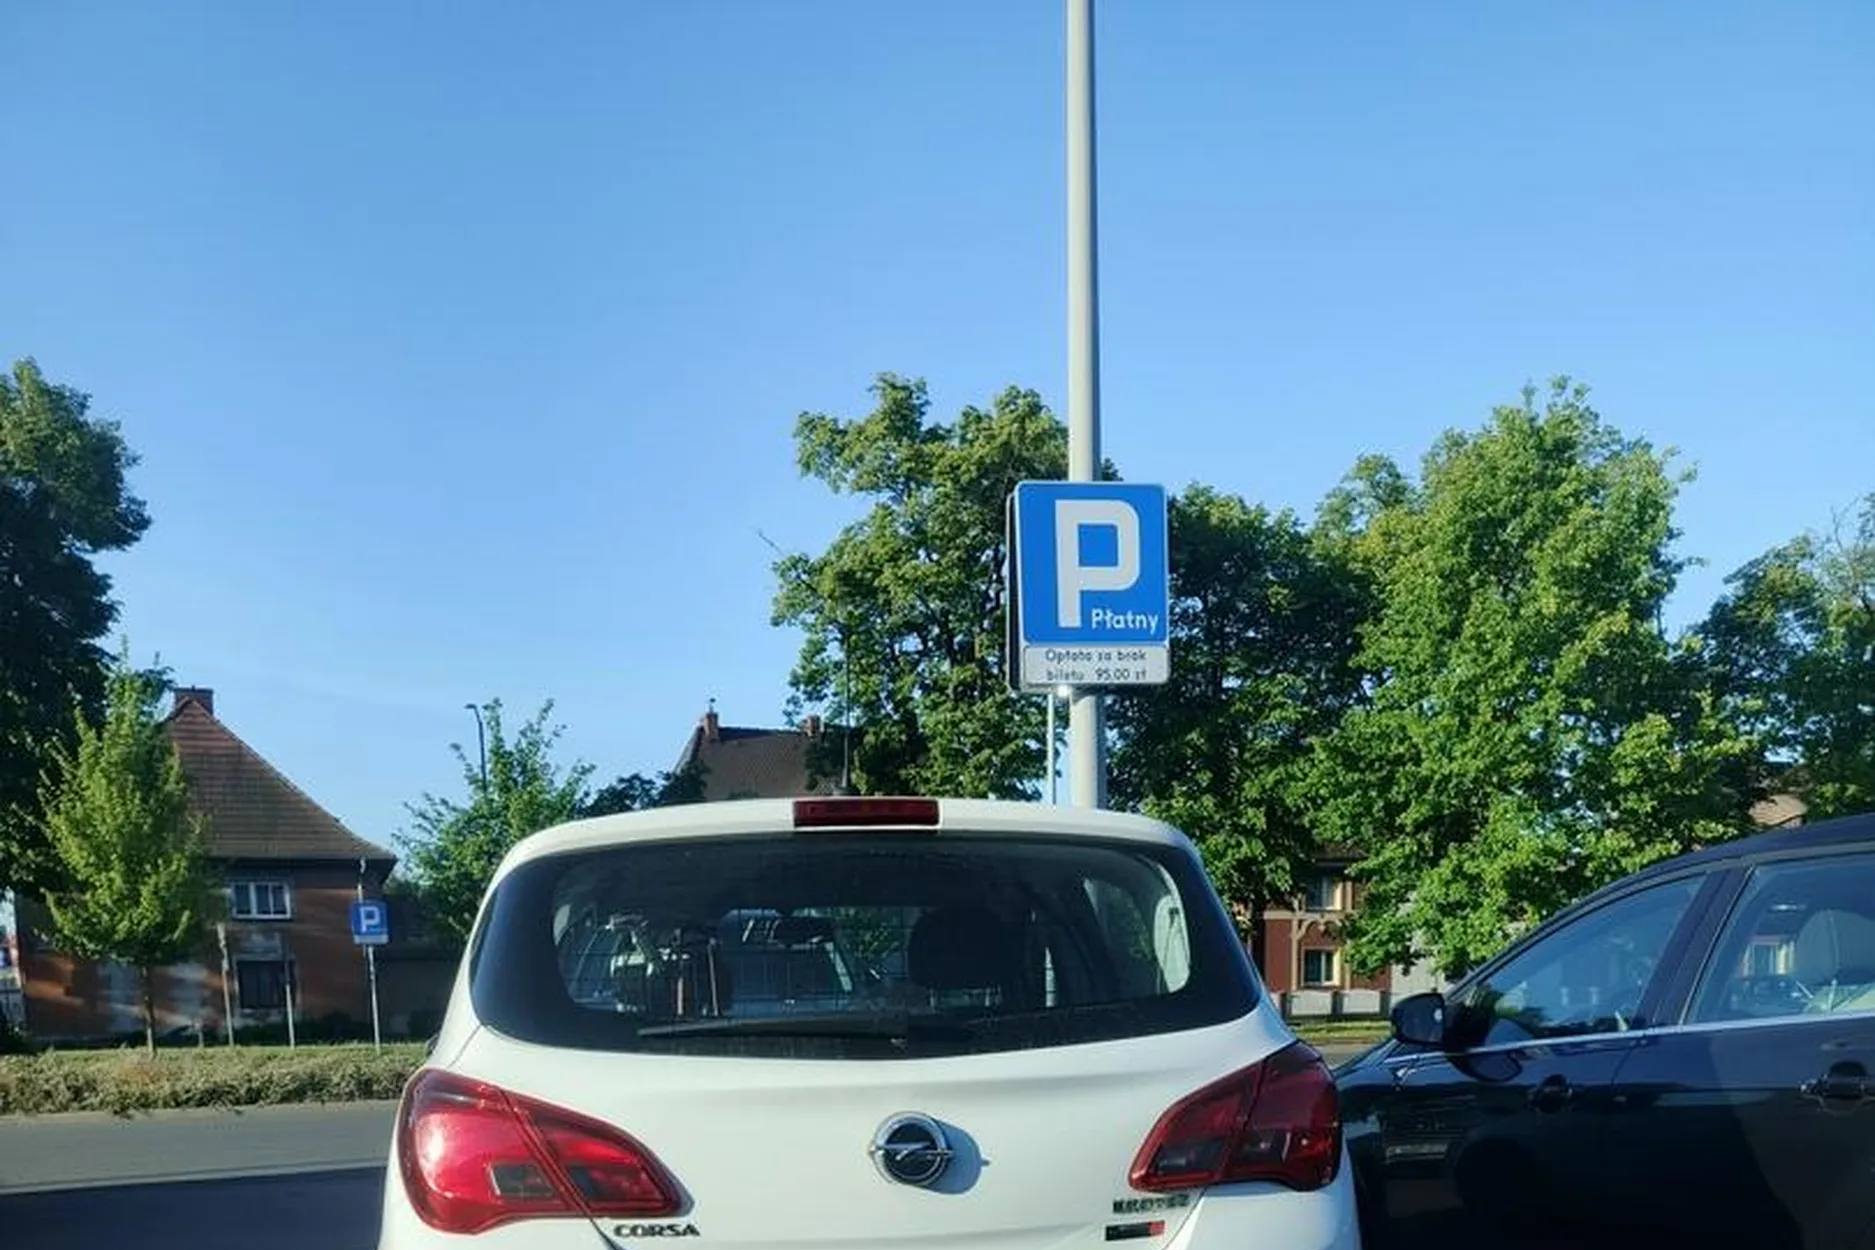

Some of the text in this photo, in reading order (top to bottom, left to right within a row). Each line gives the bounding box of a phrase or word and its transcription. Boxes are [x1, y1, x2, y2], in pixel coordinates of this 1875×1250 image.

[1055, 499, 1140, 628] P
[1091, 609, 1158, 634] Płatny
[360, 906, 380, 933] P
[614, 1224, 700, 1237] CORSA
